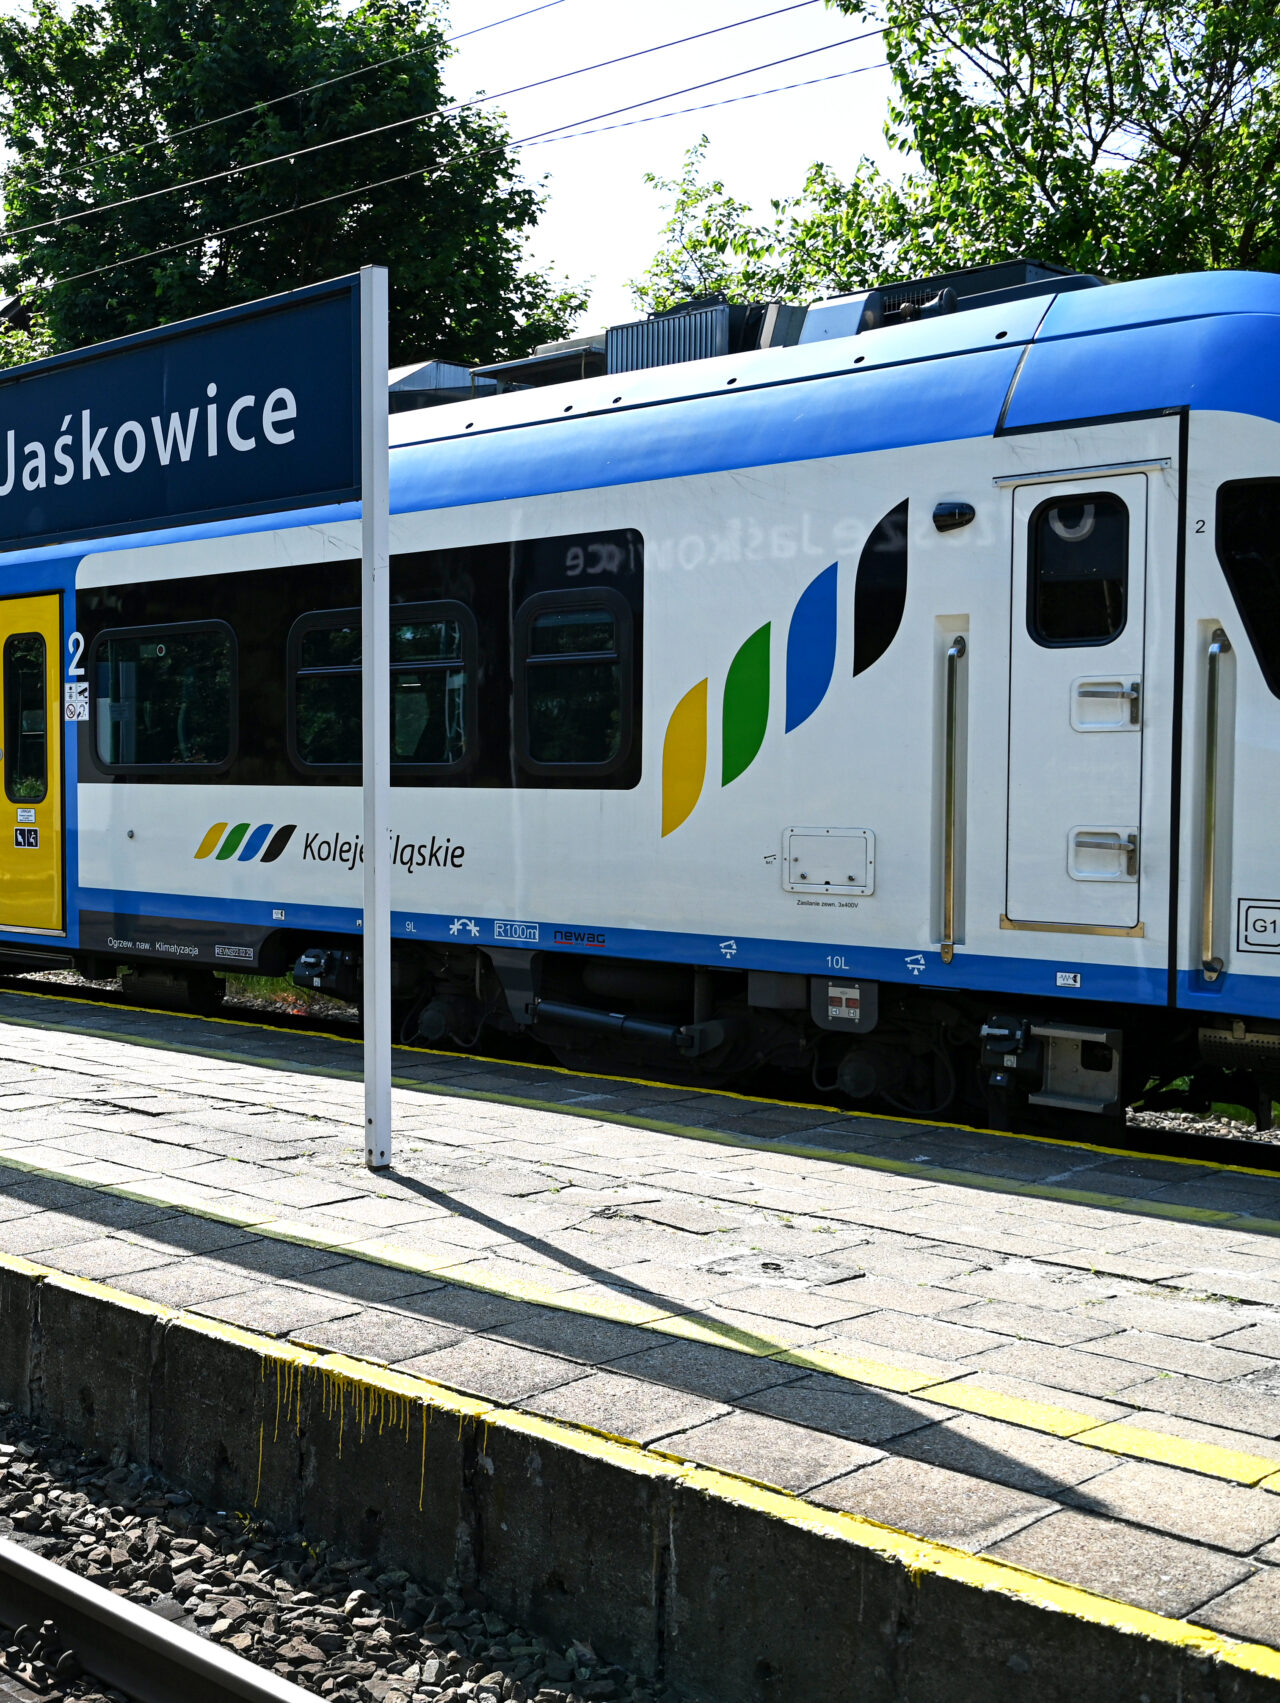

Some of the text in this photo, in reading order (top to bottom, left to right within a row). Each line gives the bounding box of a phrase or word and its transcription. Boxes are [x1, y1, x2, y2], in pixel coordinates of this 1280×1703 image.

[1195, 519, 1206, 533] 2
[68, 631, 85, 676] 2
[390, 829, 465, 873] ląskie
[405, 921, 416, 933] 9L
[496, 924, 538, 939] R100m
[554, 930, 606, 944] newag
[107, 937, 199, 957] Ogrzew. naw. Klimatyzacja
[826, 955, 850, 970] 10L
